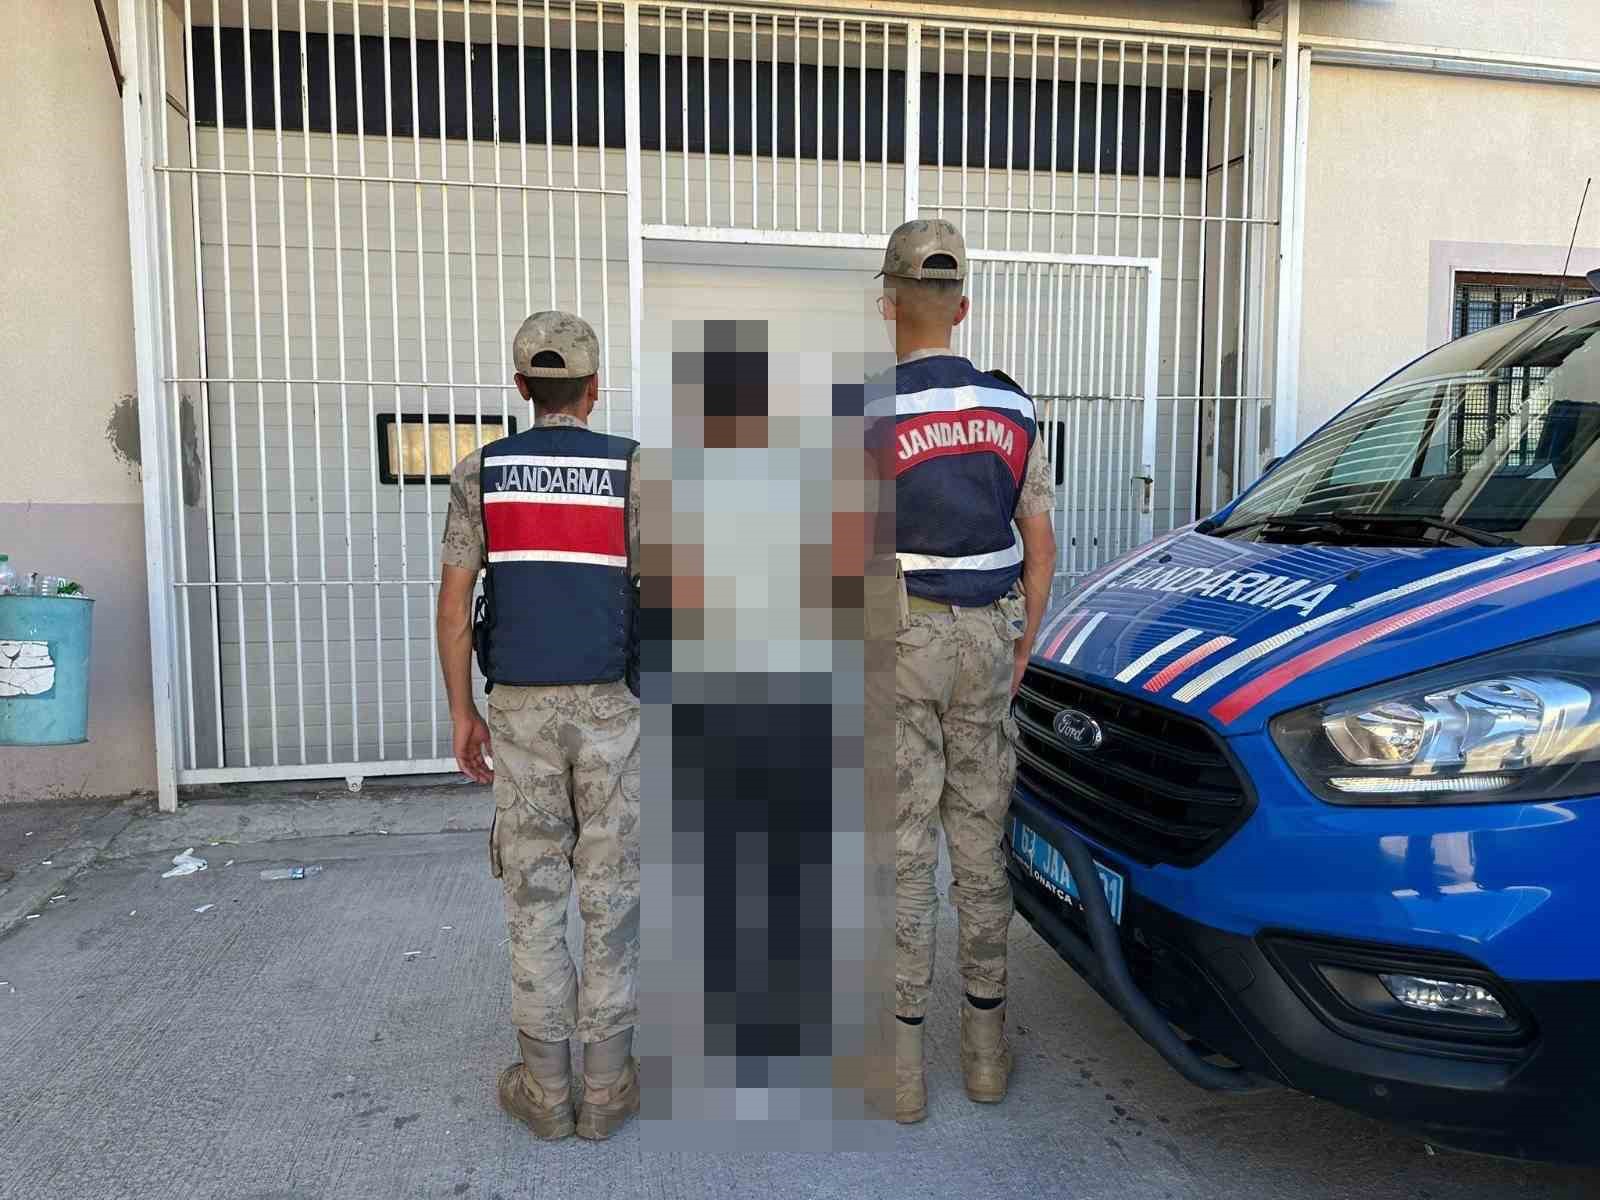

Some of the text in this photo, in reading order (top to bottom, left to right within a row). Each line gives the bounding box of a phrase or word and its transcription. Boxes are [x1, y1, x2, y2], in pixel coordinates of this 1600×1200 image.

[897, 419, 1014, 460] JANDARMA
[495, 465, 614, 495] JANDARMA
[1106, 566, 1337, 617] JANDARMA
[1058, 714, 1085, 741] Ford
